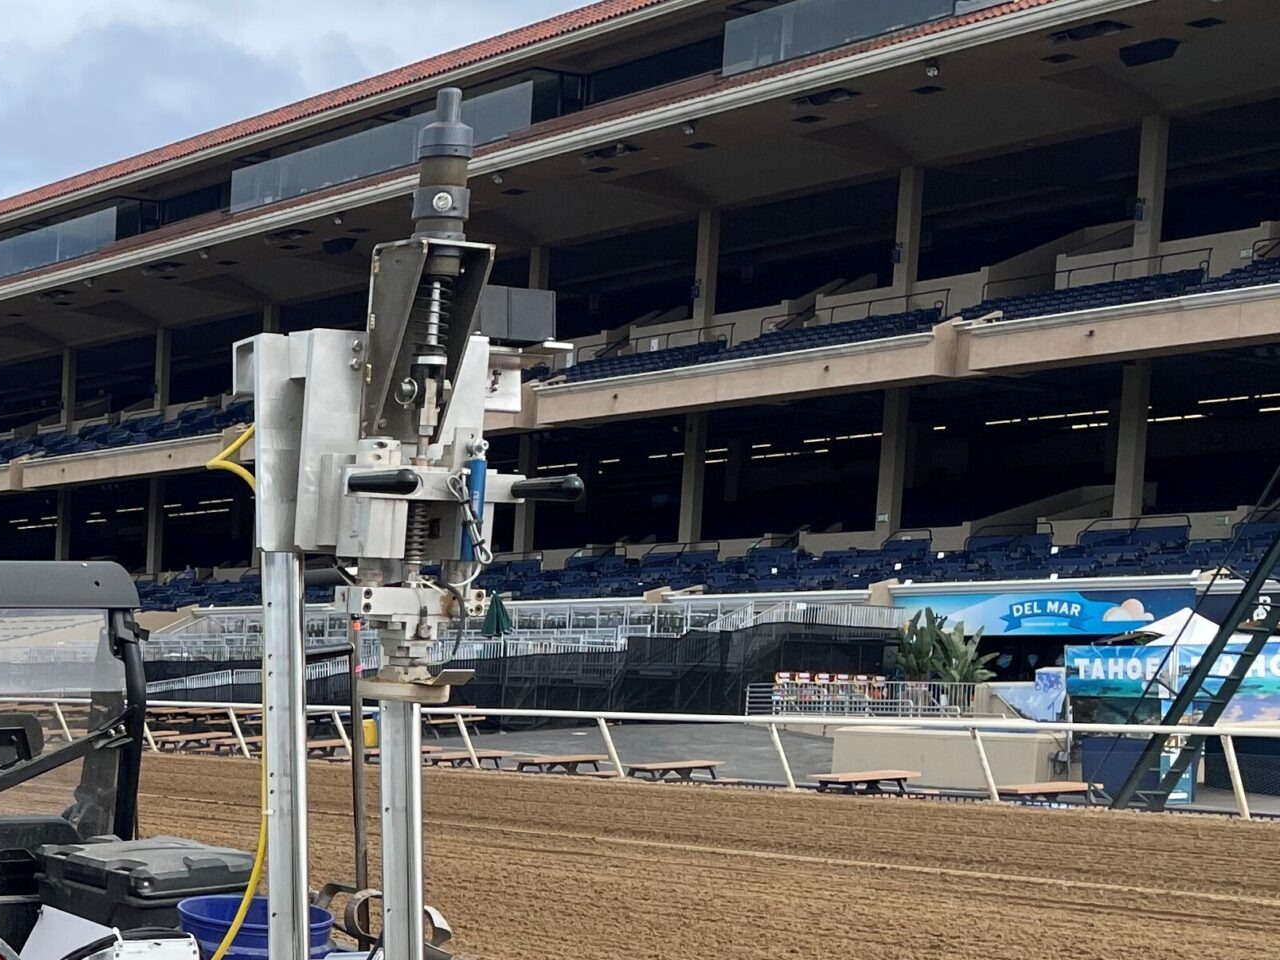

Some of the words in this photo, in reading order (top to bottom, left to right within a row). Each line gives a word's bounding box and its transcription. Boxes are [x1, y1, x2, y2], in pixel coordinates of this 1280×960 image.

[1012, 601, 1041, 617] DEL
[1046, 601, 1081, 617] MAR
[1074, 657, 1161, 680] TAHOE
